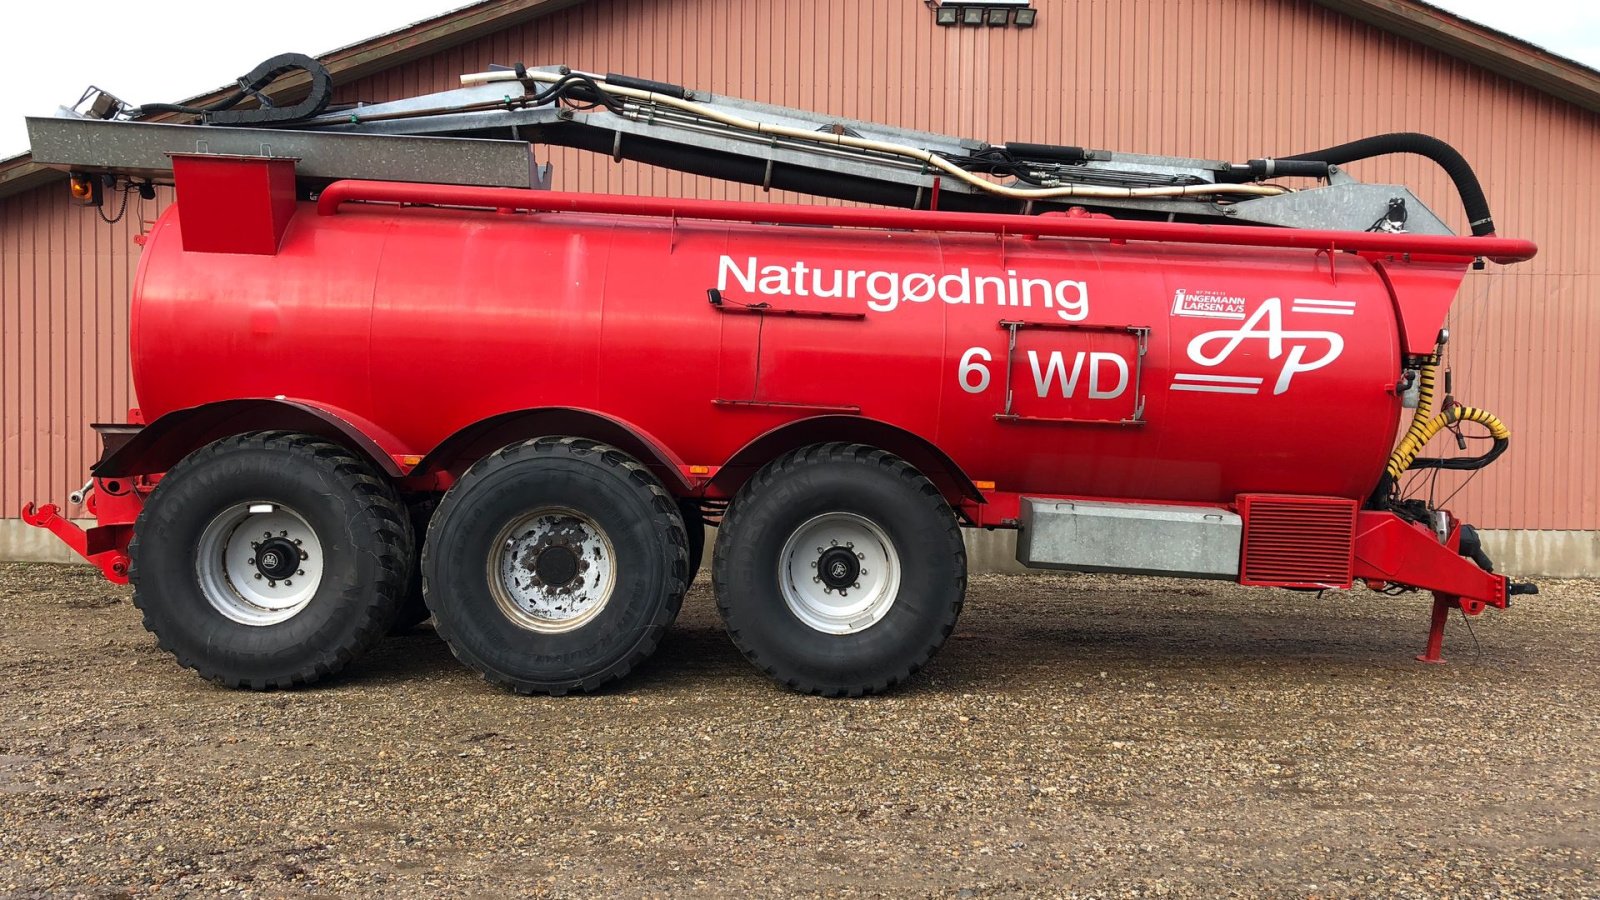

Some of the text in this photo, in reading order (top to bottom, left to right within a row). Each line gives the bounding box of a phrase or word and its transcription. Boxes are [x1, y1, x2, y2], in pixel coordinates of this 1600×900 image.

[716, 254, 1091, 322] Naturgødning
[1183, 302, 1224, 312] LARSEN
[958, 346, 1129, 399] 6 WD
[1187, 296, 1345, 396] AP
